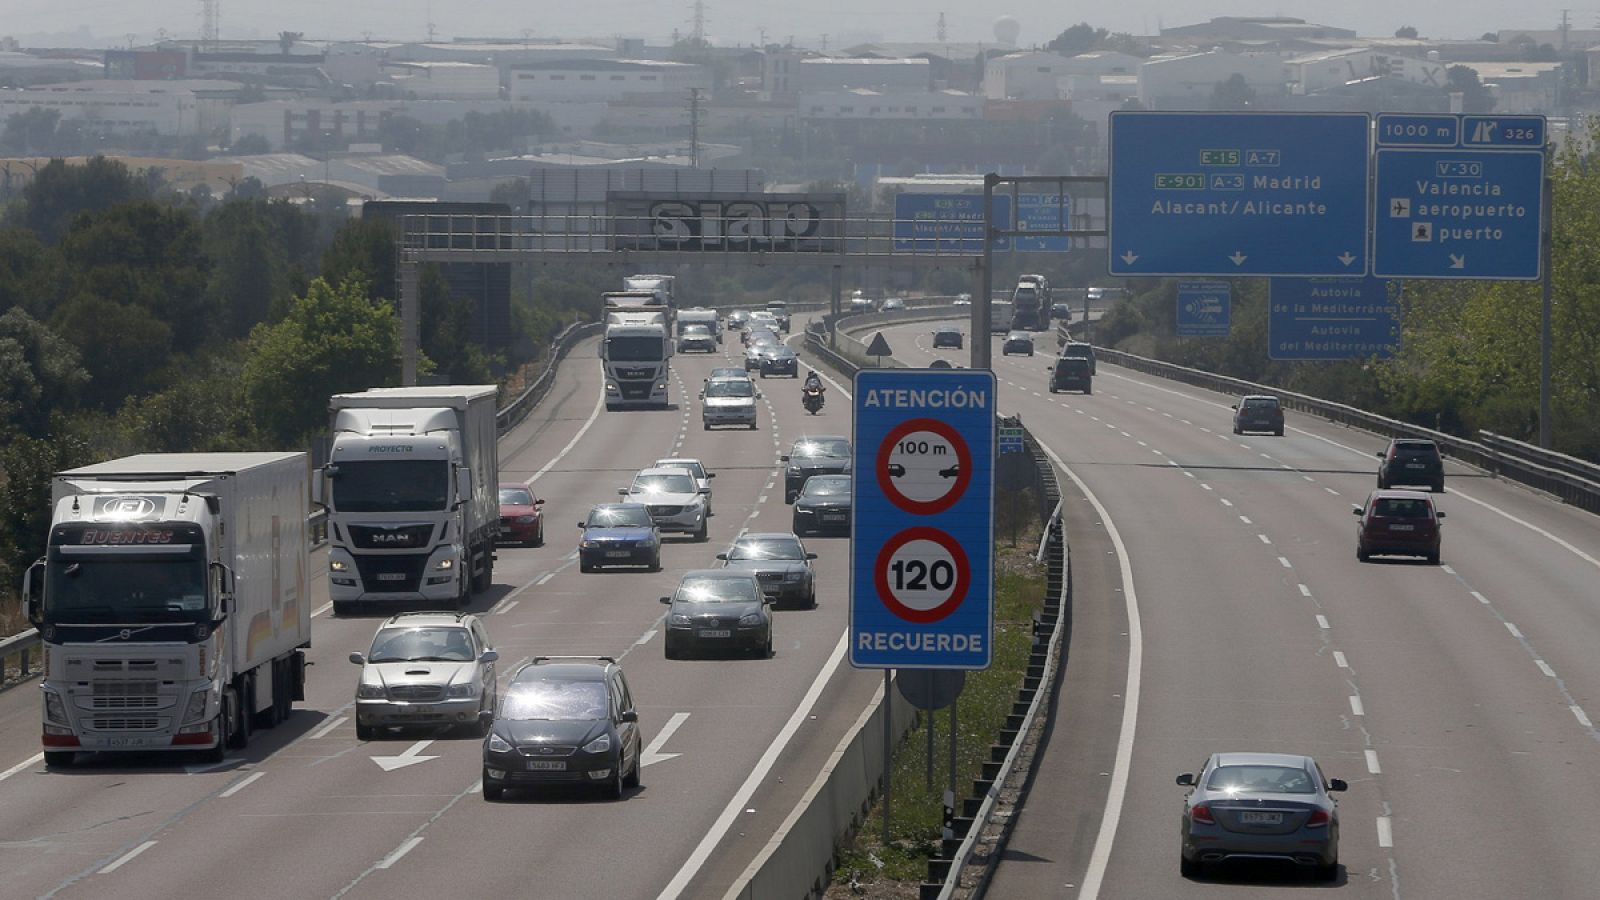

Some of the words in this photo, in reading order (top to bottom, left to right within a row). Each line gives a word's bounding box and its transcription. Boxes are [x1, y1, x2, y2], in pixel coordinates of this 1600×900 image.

[1386, 125, 1428, 137] 1000
[1437, 127, 1449, 137] m
[1505, 129, 1534, 140] 326
[1202, 152, 1238, 164] E-15
[1248, 152, 1276, 164] A-7
[1439, 164, 1480, 175] V-30
[1157, 176, 1204, 187] E-901
[1214, 176, 1243, 187] A-3
[1253, 175, 1321, 189] Madrid
[1417, 181, 1501, 196] Valencia
[1151, 200, 1327, 215] Alacant/Alicante
[1418, 204, 1525, 219] aeropuerto
[1440, 226, 1502, 243] puerto
[1274, 304, 1289, 313] de
[1294, 304, 1305, 313] la
[1280, 342, 1299, 351] del
[864, 385, 985, 408] ATENCIÓN
[899, 441, 929, 454] 100
[933, 444, 947, 455] m
[81, 529, 173, 544] FUENTES
[372, 534, 409, 542] MAN
[891, 559, 954, 591] 120
[858, 632, 982, 653] RECUERDE
